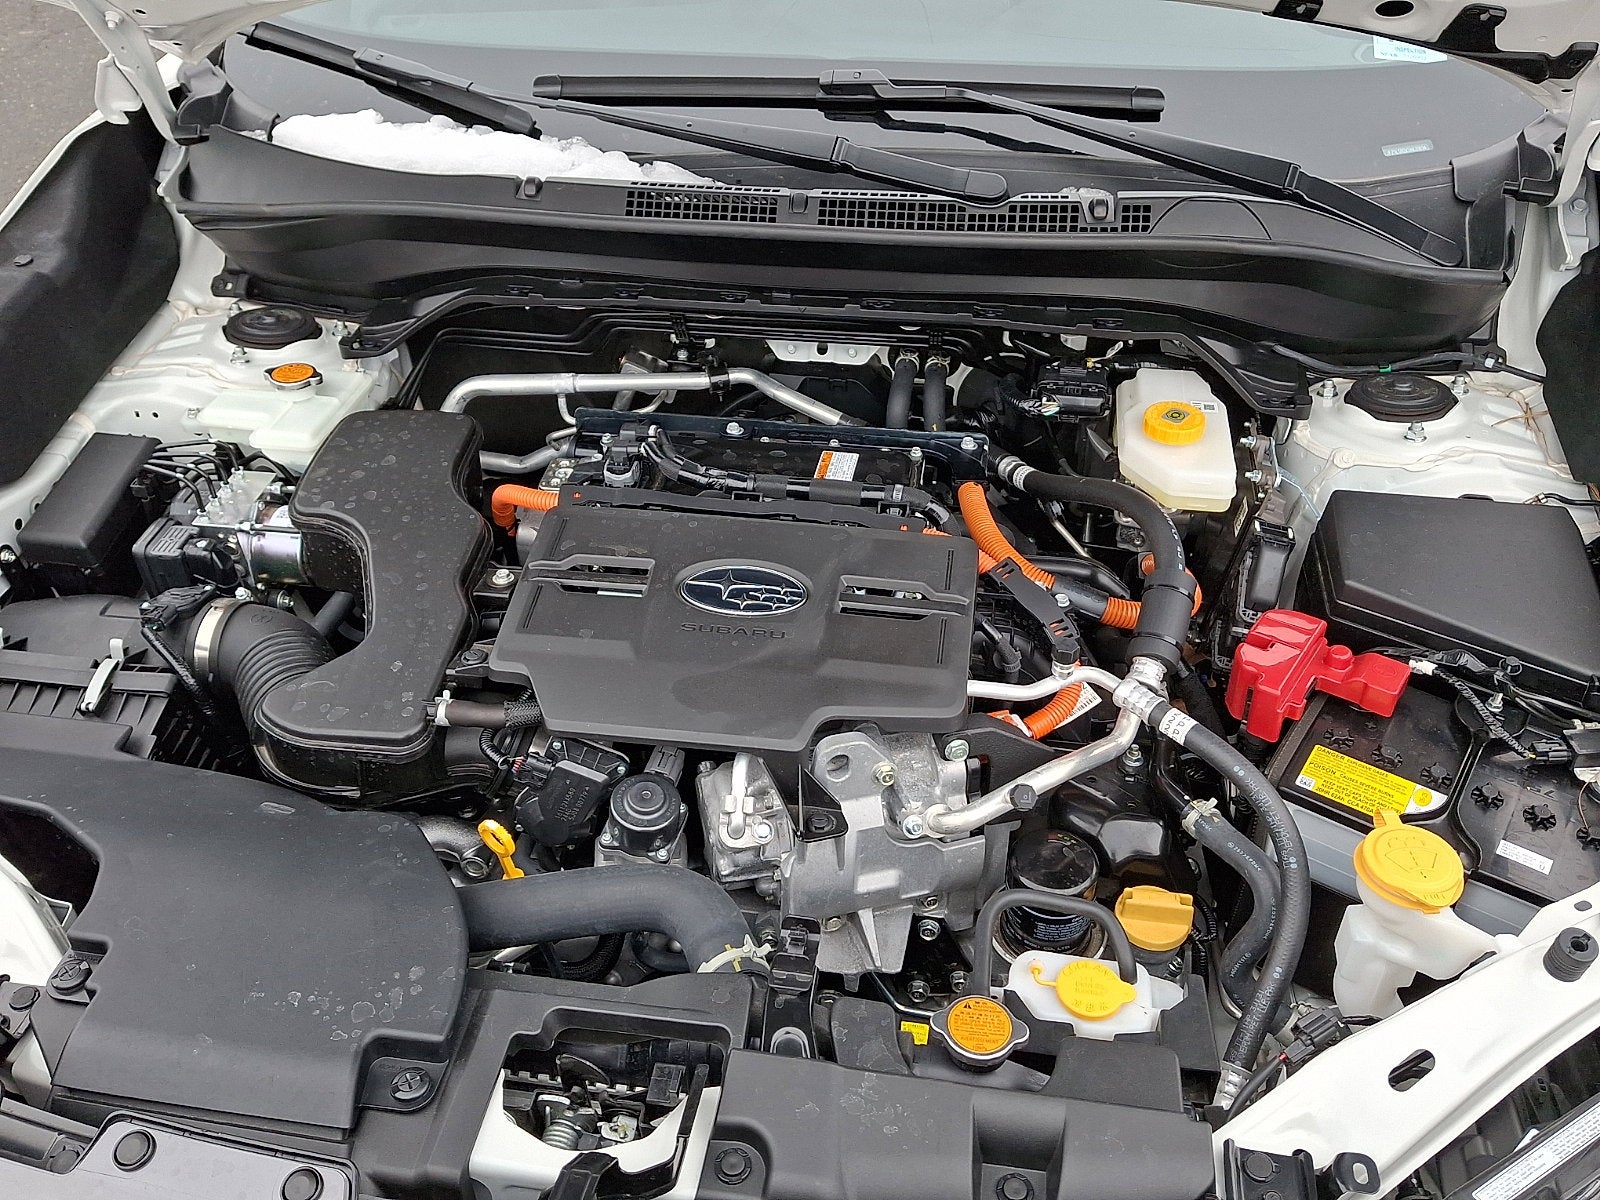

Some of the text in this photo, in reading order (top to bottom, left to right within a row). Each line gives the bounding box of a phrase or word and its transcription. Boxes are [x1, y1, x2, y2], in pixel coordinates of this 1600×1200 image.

[681, 623, 786, 639] SUBARU
[1316, 746, 1388, 778] DANGER EXPLOSIVE GASES
[1308, 760, 1394, 798] POISON CAUSES SEVERE BURNS
[1322, 779, 1335, 787] KEEP
[1348, 790, 1362, 798] CAPS
[1362, 795, 1376, 803] TIGHT
[1350, 795, 1369, 805] REACH
[1346, 799, 1359, 807] CCA
